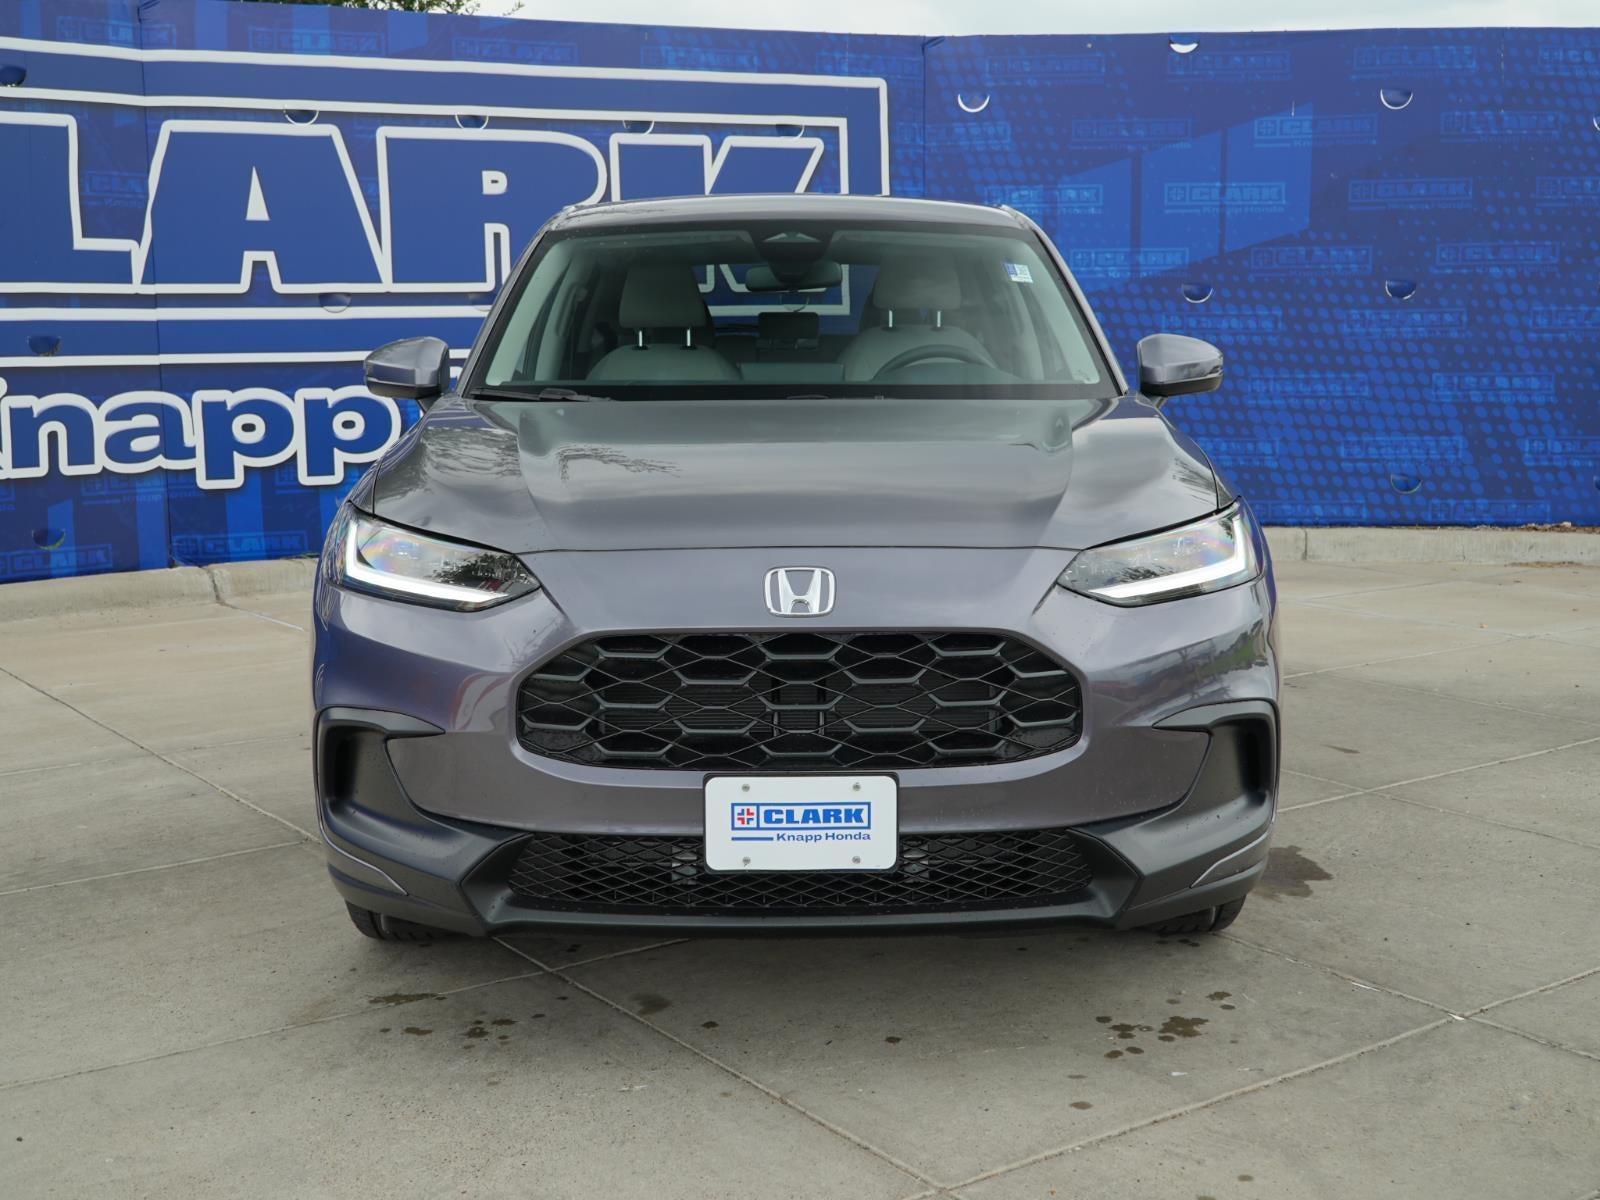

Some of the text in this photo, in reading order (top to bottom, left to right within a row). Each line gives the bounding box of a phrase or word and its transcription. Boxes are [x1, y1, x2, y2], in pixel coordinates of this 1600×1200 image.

[1282, 118, 1370, 133] CLARK
[1191, 187, 1280, 200] CLARK
[1377, 182, 1466, 197] CLARK
[1097, 252, 1182, 266] CLARK
[0, 380, 401, 489] napp
[203, 534, 302, 555] CLARK
[14, 549, 108, 571] CLARK
[763, 807, 864, 825] CLARK
[776, 831, 871, 844] Knapp Honda
